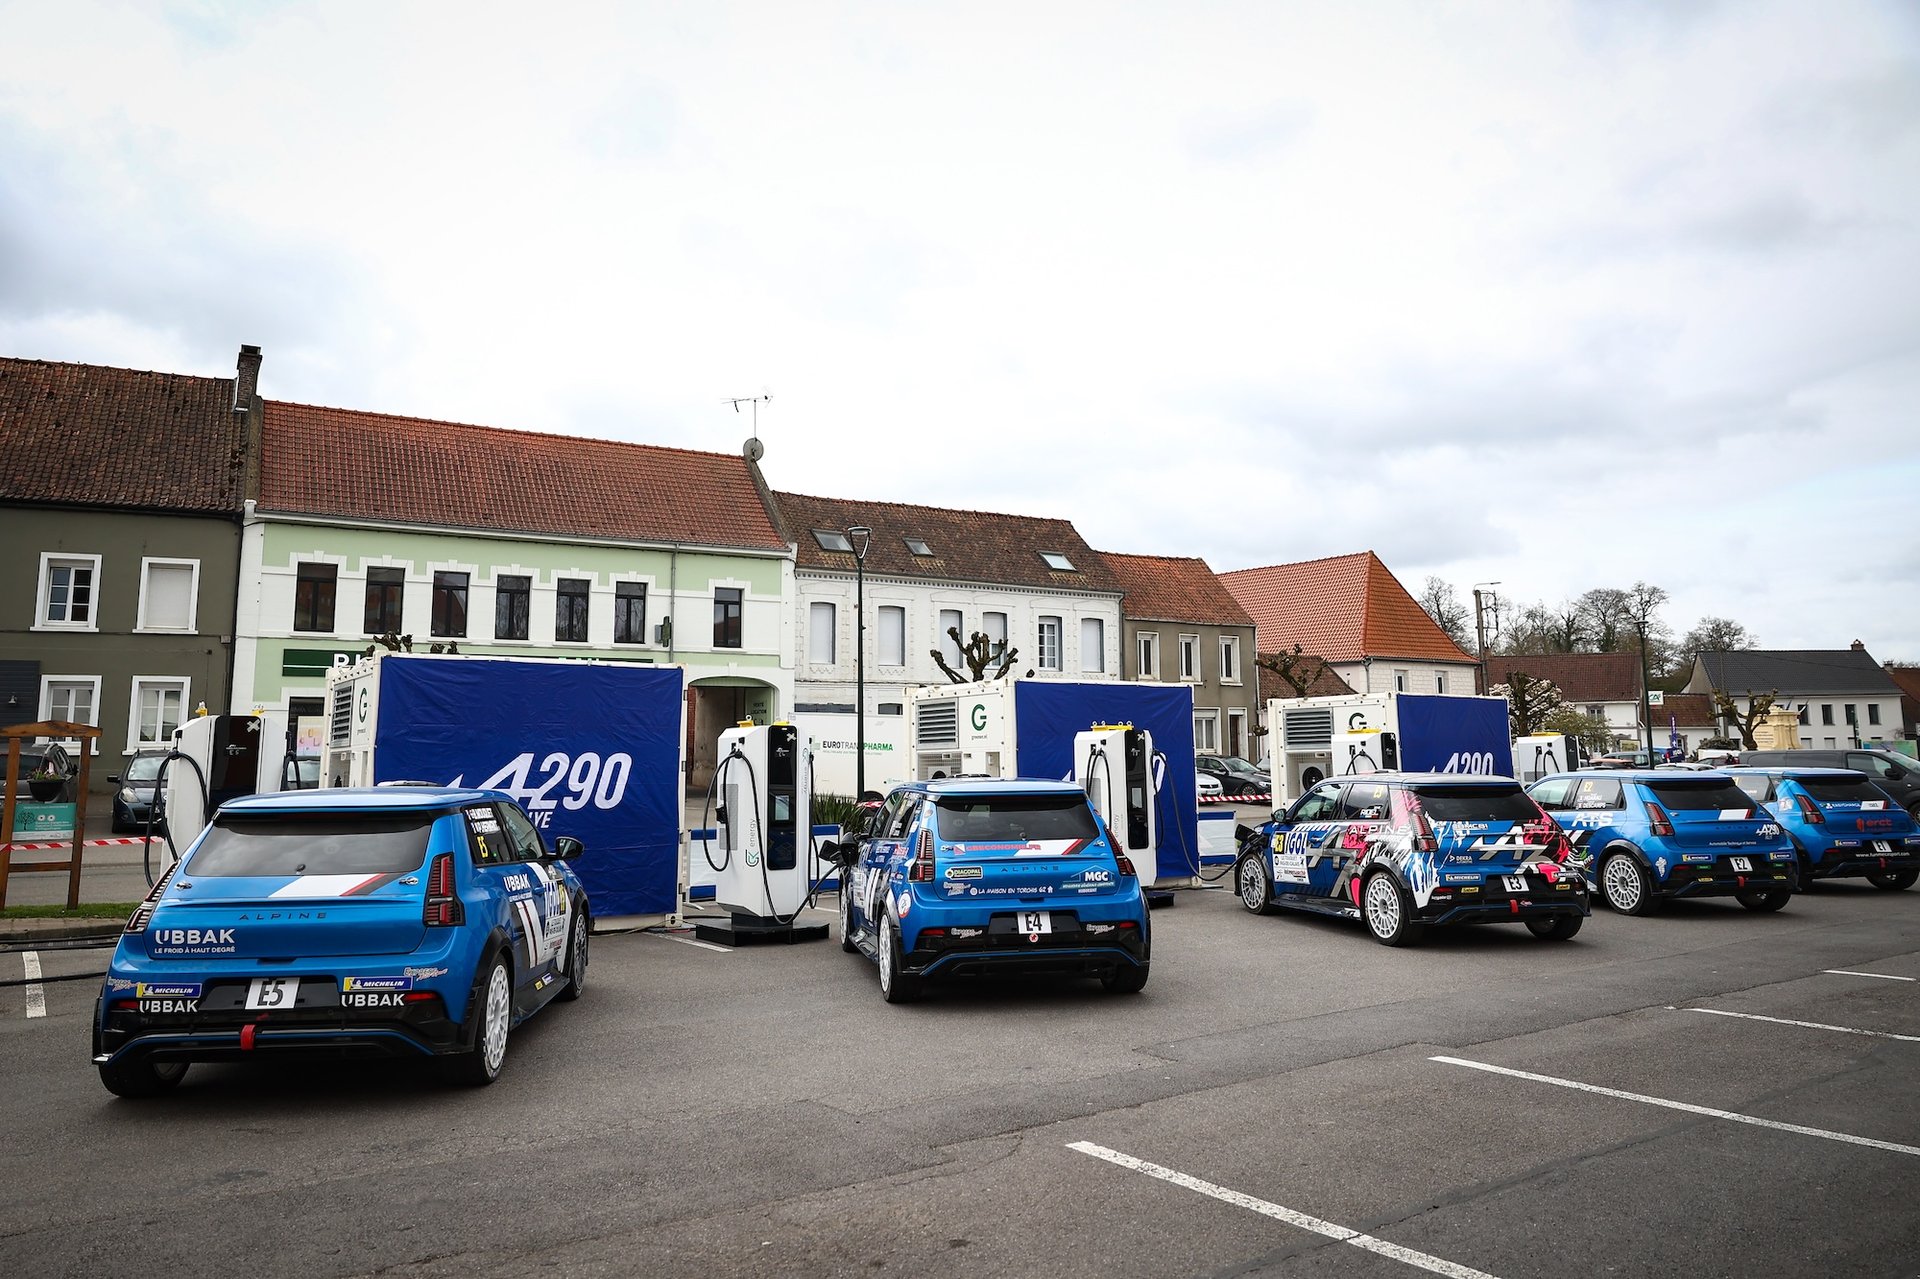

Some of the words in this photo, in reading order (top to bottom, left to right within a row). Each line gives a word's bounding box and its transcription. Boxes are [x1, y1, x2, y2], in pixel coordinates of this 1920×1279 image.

[822, 740, 894, 751] EUROTRANPHARMA
[749, 818, 757, 847] energy
[1349, 825, 1407, 835] ALPINE
[1285, 832, 1306, 854] IGOL
[1735, 859, 1748, 870] E2
[1084, 871, 1109, 882] MGC
[1509, 876, 1522, 890] E3
[239, 912, 328, 920] ALPINE
[1025, 913, 1043, 932] E4
[155, 929, 236, 945] UBBAK
[257, 980, 286, 1006] E5
[341, 993, 405, 1007] UBBAK
[140, 1000, 199, 1013] UBBAK
